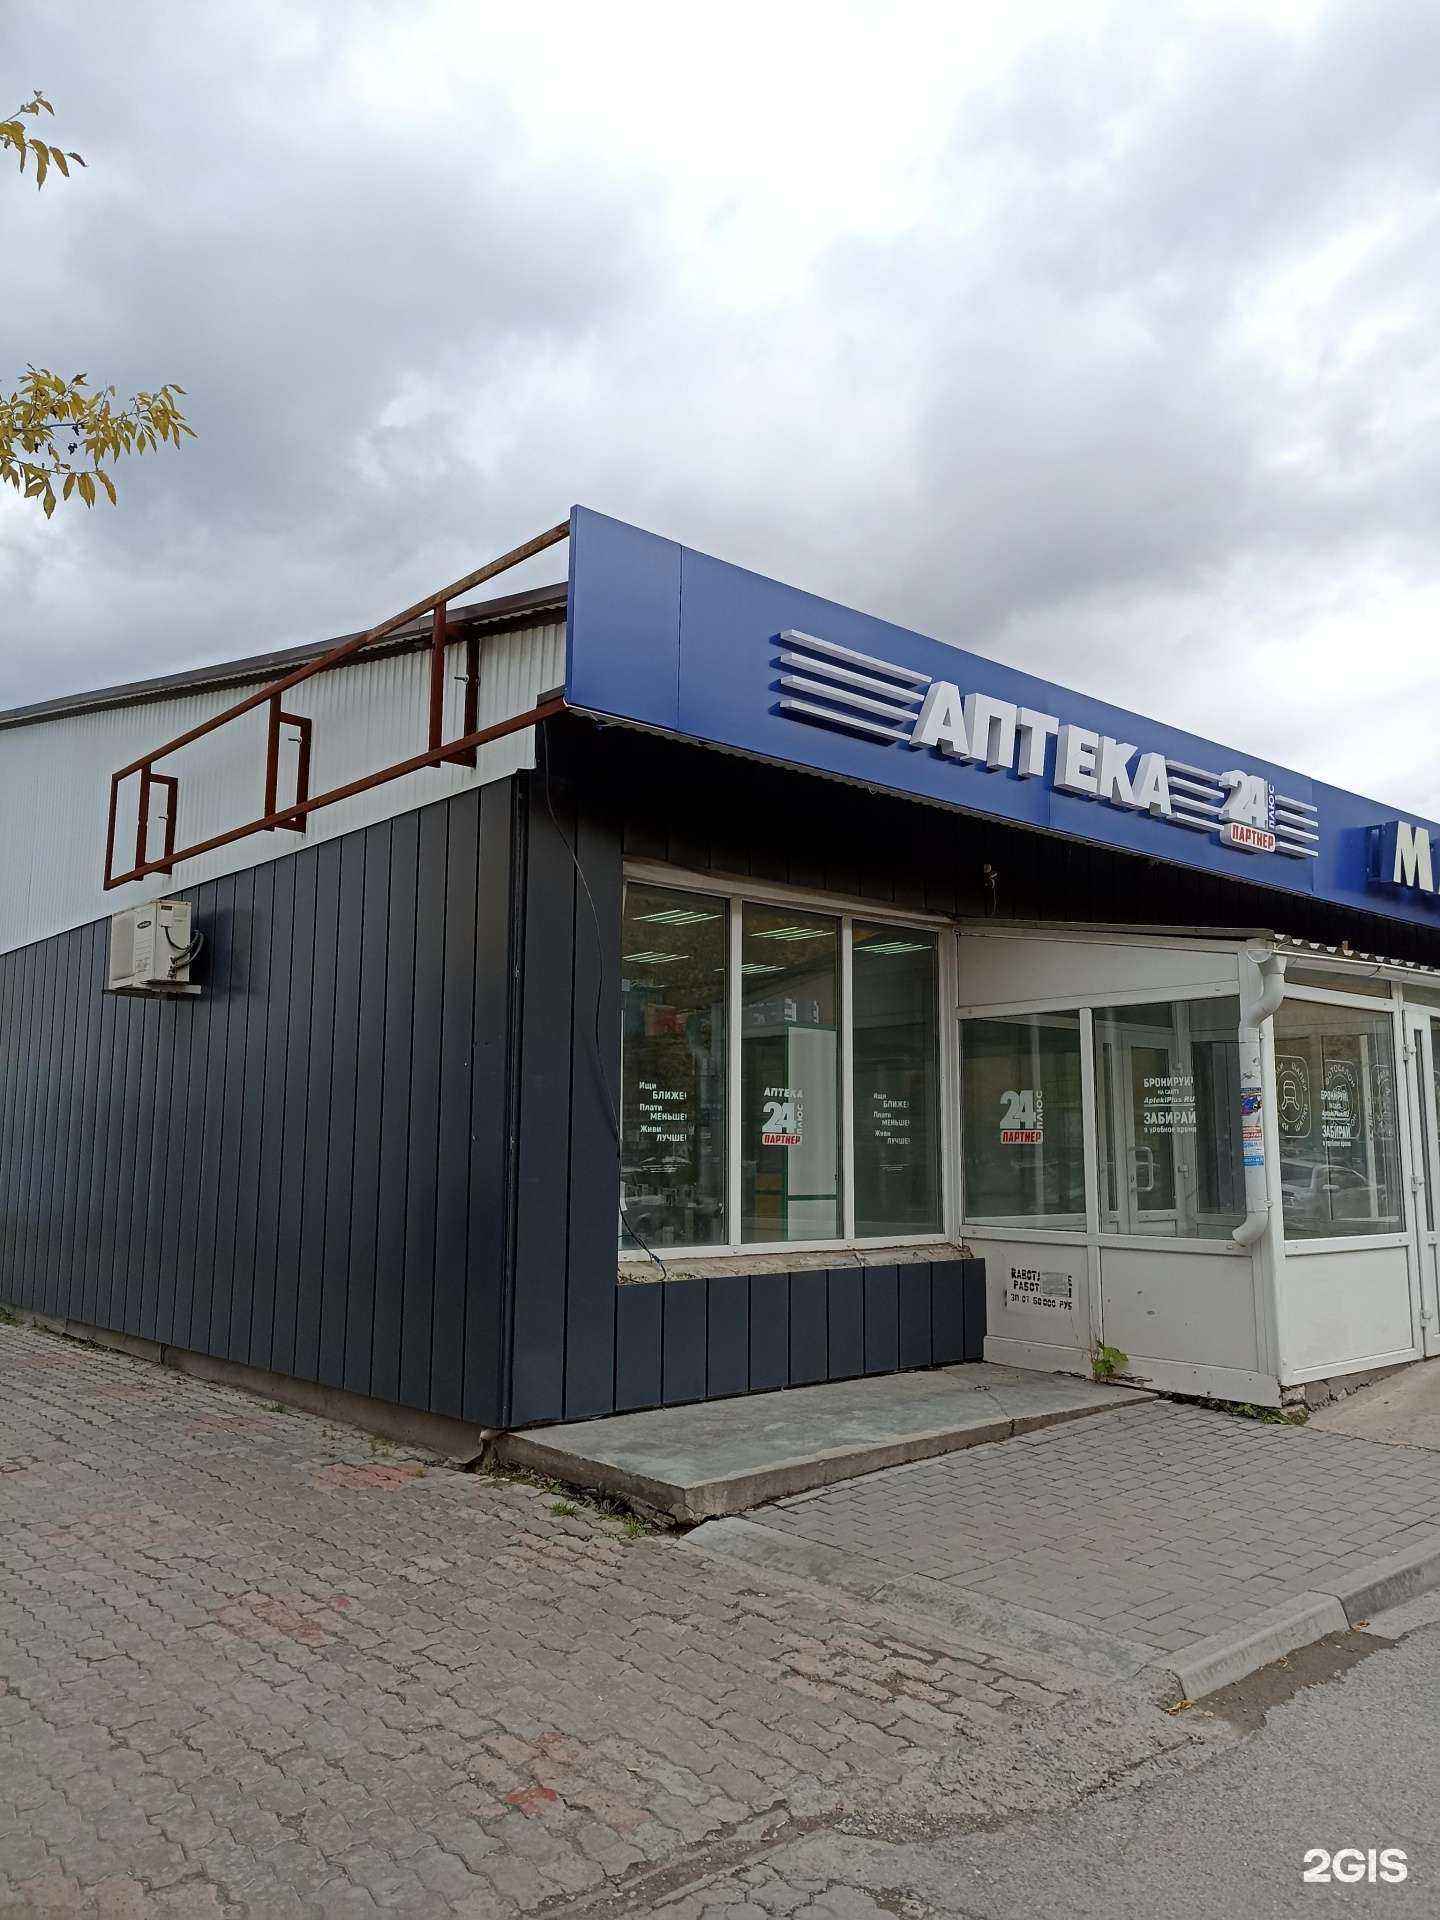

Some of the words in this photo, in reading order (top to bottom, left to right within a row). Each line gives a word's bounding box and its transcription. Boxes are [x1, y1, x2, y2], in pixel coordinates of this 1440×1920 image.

[909, 681, 1172, 817] АПТЕКА
[1219, 770, 1268, 829] 24
[1231, 823, 1275, 850] ПАРТНЕР
[1393, 820, 1438, 893] М
[639, 1081, 657, 1091] Ищи
[652, 1090, 687, 1100] БЛИЖЕ!
[764, 1087, 804, 1098] АПТЕКА
[639, 1103, 663, 1112] Плати
[1000, 1089, 1036, 1129] 24
[649, 1112, 688, 1121] МЕНЬШЕ!
[762, 1101, 798, 1133] 24
[1143, 1108, 1197, 1125] ЗАБИРАЙ
[640, 1124, 662, 1133] Живи
[656, 1133, 687, 1142] ЛУЧШЕ!
[764, 1134, 801, 1145] ПАРТНЕР
[1002, 1130, 1041, 1143] ПАРТНЕР
[1013, 1280, 1040, 1292] РАБОТ
